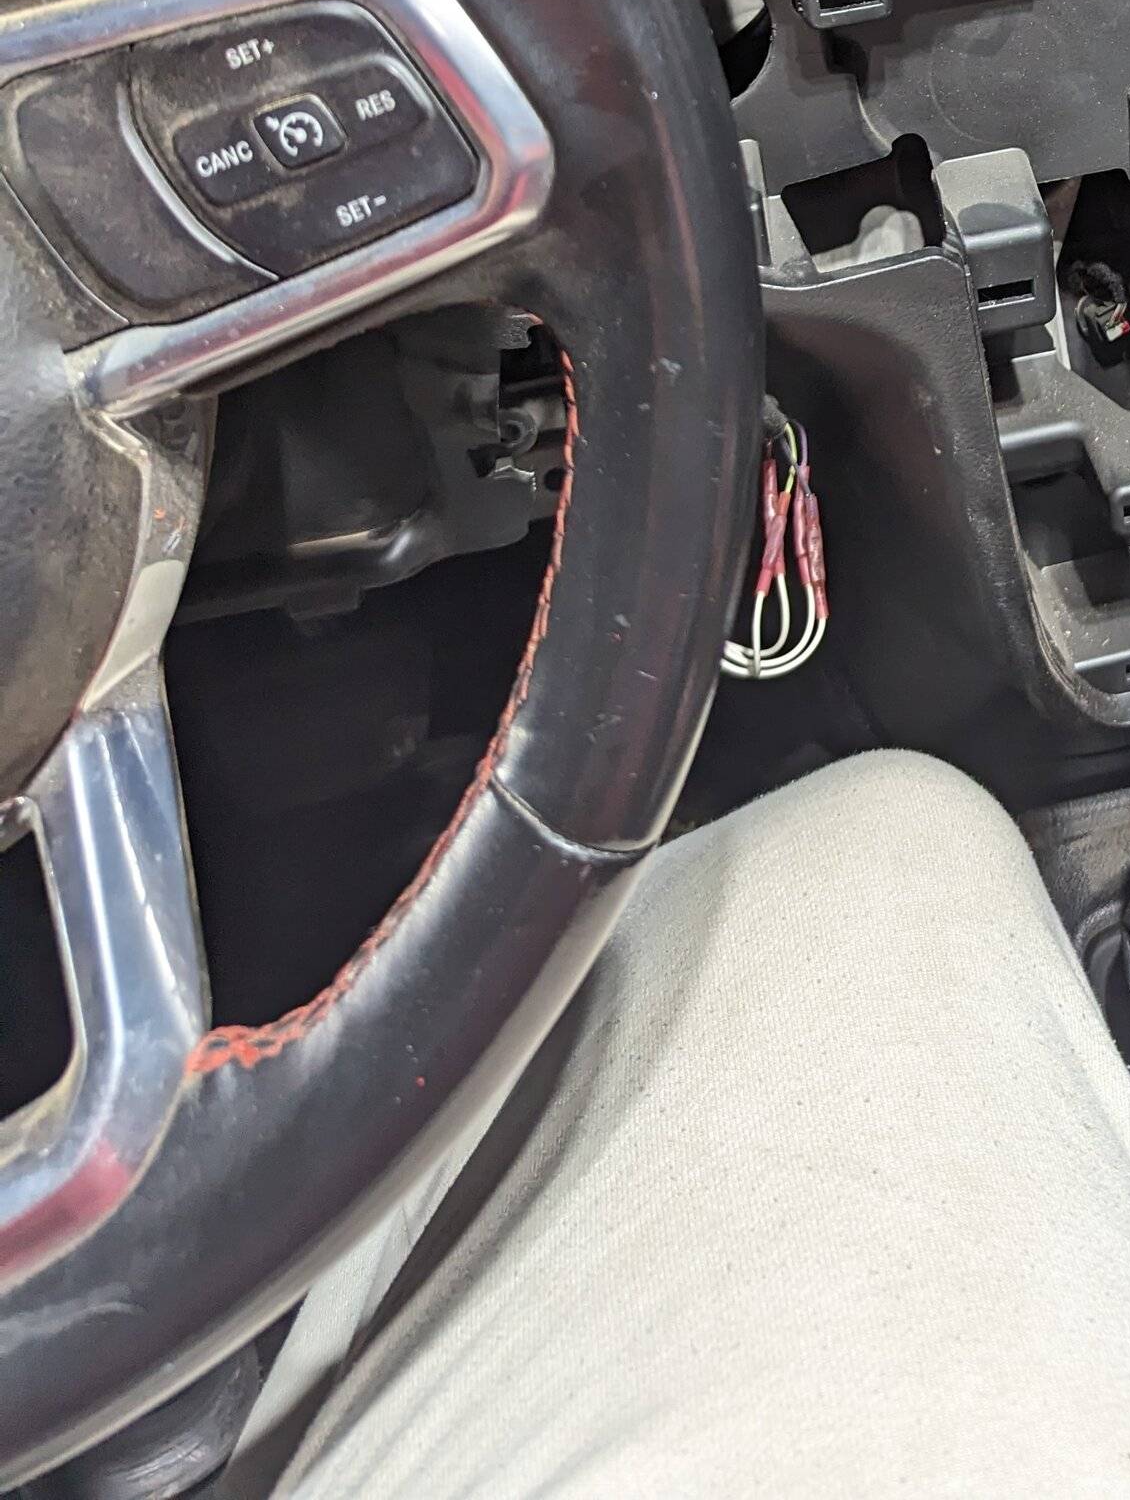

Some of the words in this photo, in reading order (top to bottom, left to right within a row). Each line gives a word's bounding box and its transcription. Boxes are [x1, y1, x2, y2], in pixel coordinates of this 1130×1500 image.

[225, 38, 275, 69] SET+
[355, 89, 398, 121] RES
[196, 140, 253, 179] CANC
